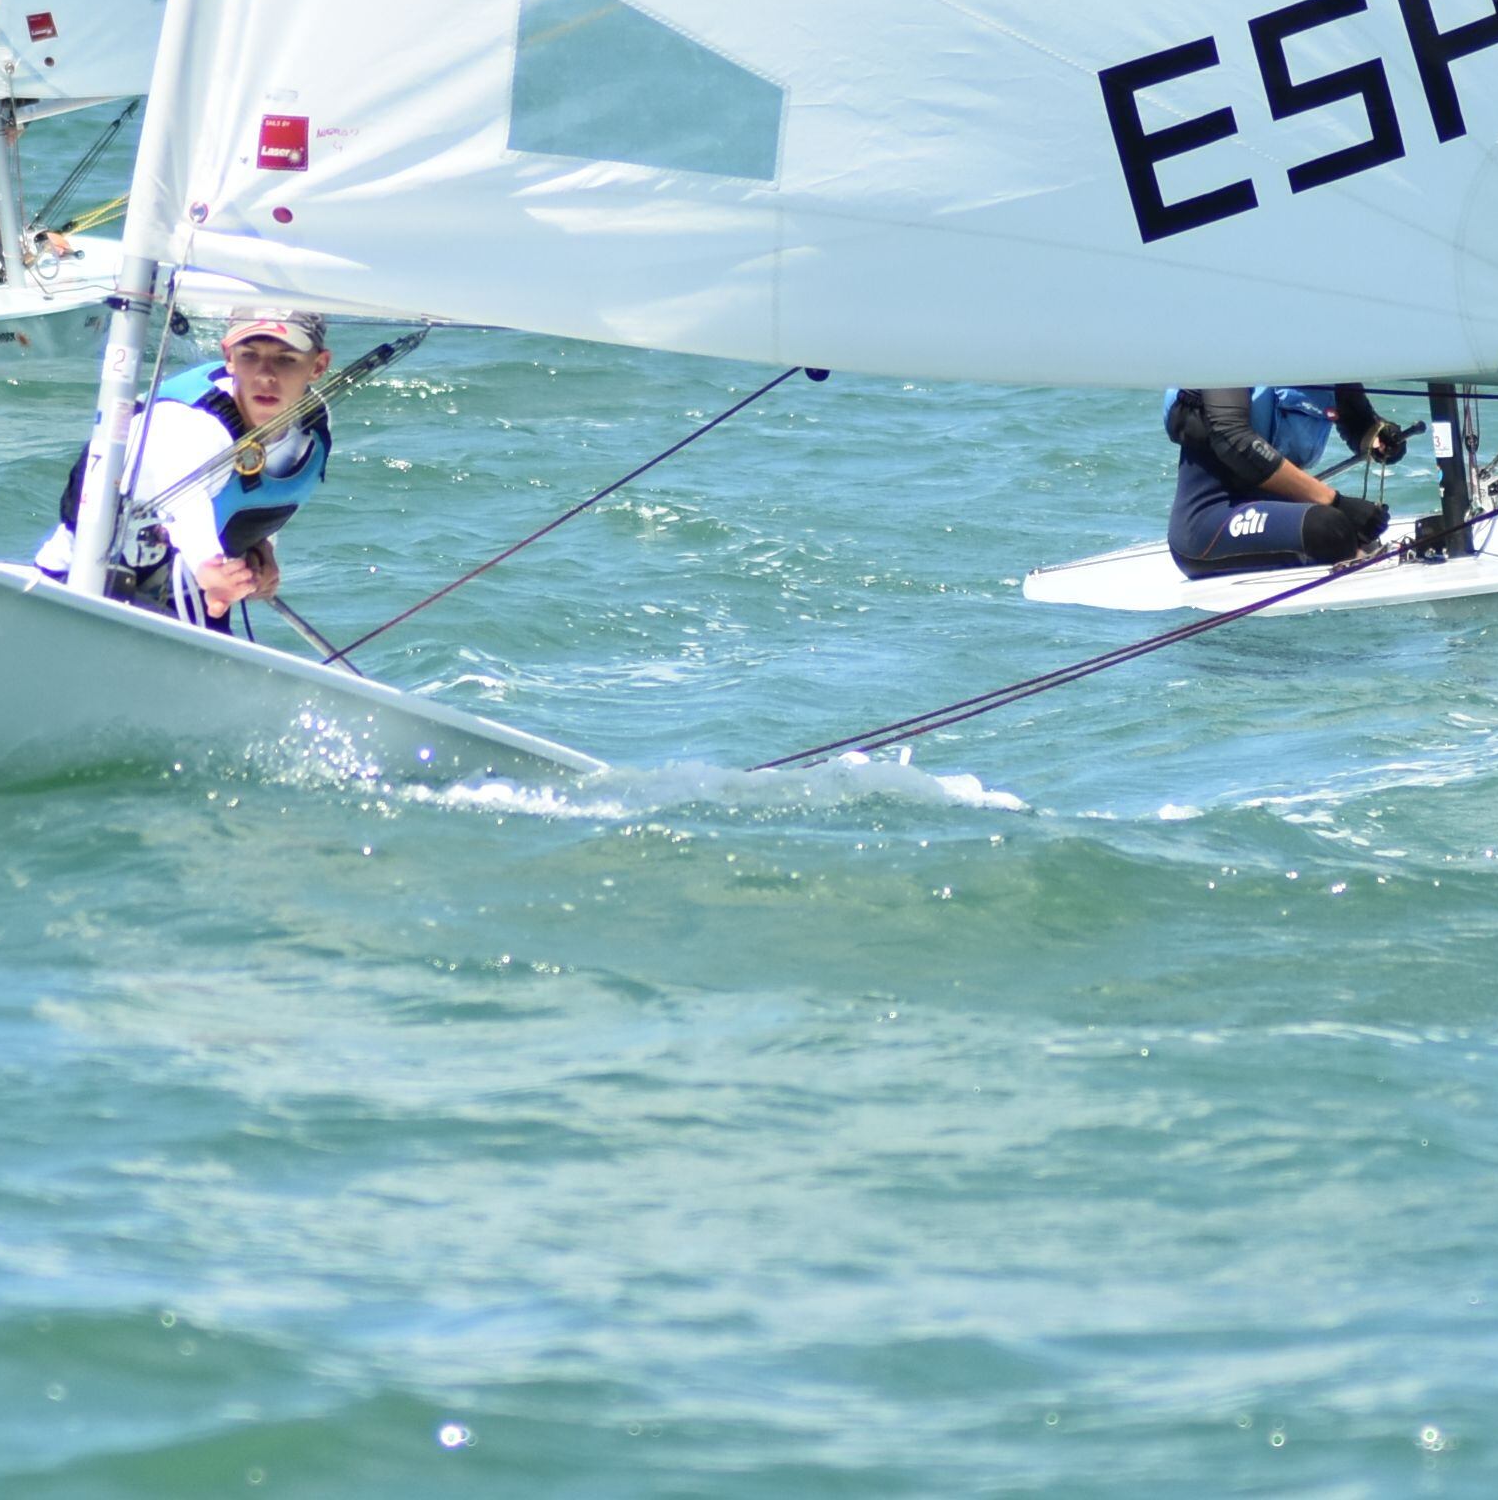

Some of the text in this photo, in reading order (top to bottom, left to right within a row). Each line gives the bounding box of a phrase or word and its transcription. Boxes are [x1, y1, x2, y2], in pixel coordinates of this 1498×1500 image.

[261, 145, 291, 157] Laser
[112, 348, 127, 374] 2
[89, 455, 103, 473] 7
[1229, 508, 1269, 537] Gill
